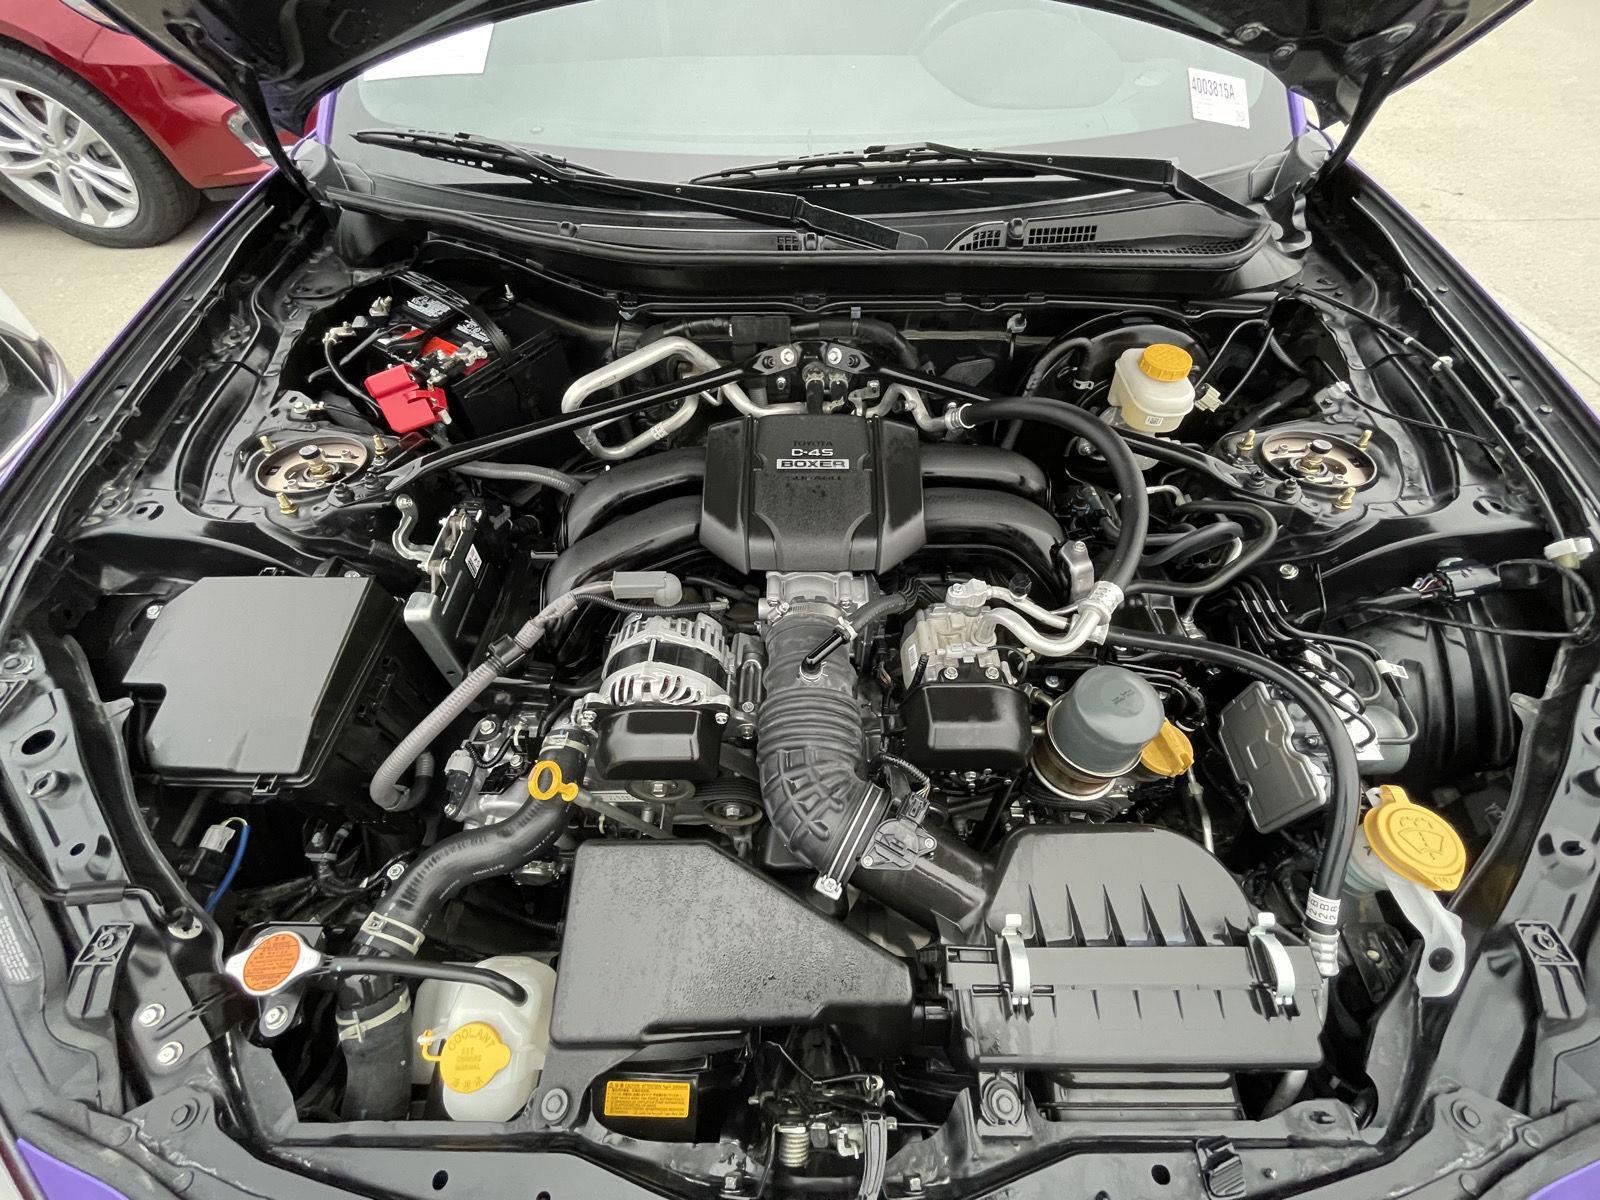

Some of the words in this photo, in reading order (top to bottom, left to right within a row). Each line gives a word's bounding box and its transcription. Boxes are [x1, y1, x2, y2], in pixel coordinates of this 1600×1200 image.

[1191, 76, 1236, 101] 4003815A
[791, 448, 834, 457] D-4S
[780, 460, 846, 468] BOXER
[448, 1027, 496, 1051] COOLANT
